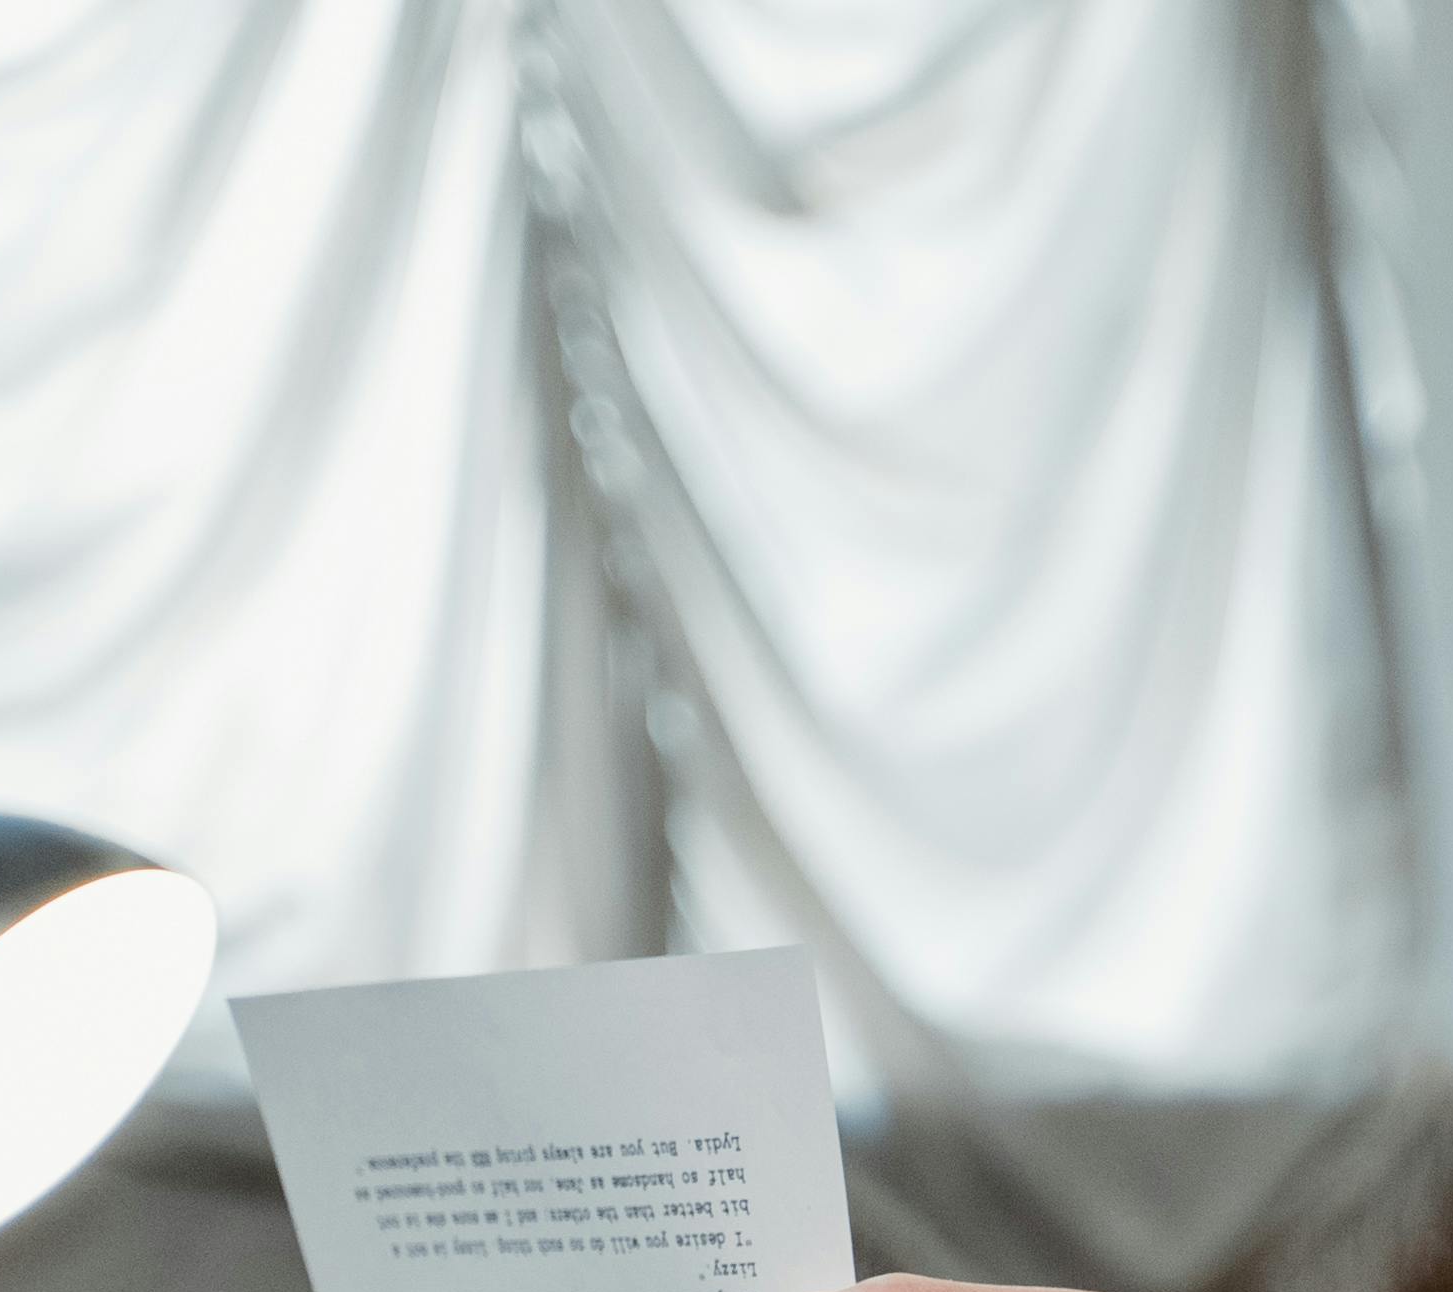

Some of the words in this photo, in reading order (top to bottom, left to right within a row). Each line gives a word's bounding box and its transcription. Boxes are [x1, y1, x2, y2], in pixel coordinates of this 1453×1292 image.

[591, 1145, 612, 1159] are
[653, 1141, 678, 1158] But
[687, 1132, 740, 1155] Lydia.
[542, 1144, 582, 1162] always
[591, 1177, 604, 1190] as
[612, 1173, 674, 1191] handsome
[682, 1171, 697, 1185] so
[709, 1168, 745, 1186] half
[596, 1206, 619, 1223] the
[624, 1206, 655, 1222] than
[663, 1202, 713, 1219] better
[720, 1199, 750, 1216] bit
[610, 1237, 640, 1254] will
[676, 1232, 725, 1250] desire
[735, 1232, 752, 1248] "I
[699, 1259, 757, 1280] Lizzy."
